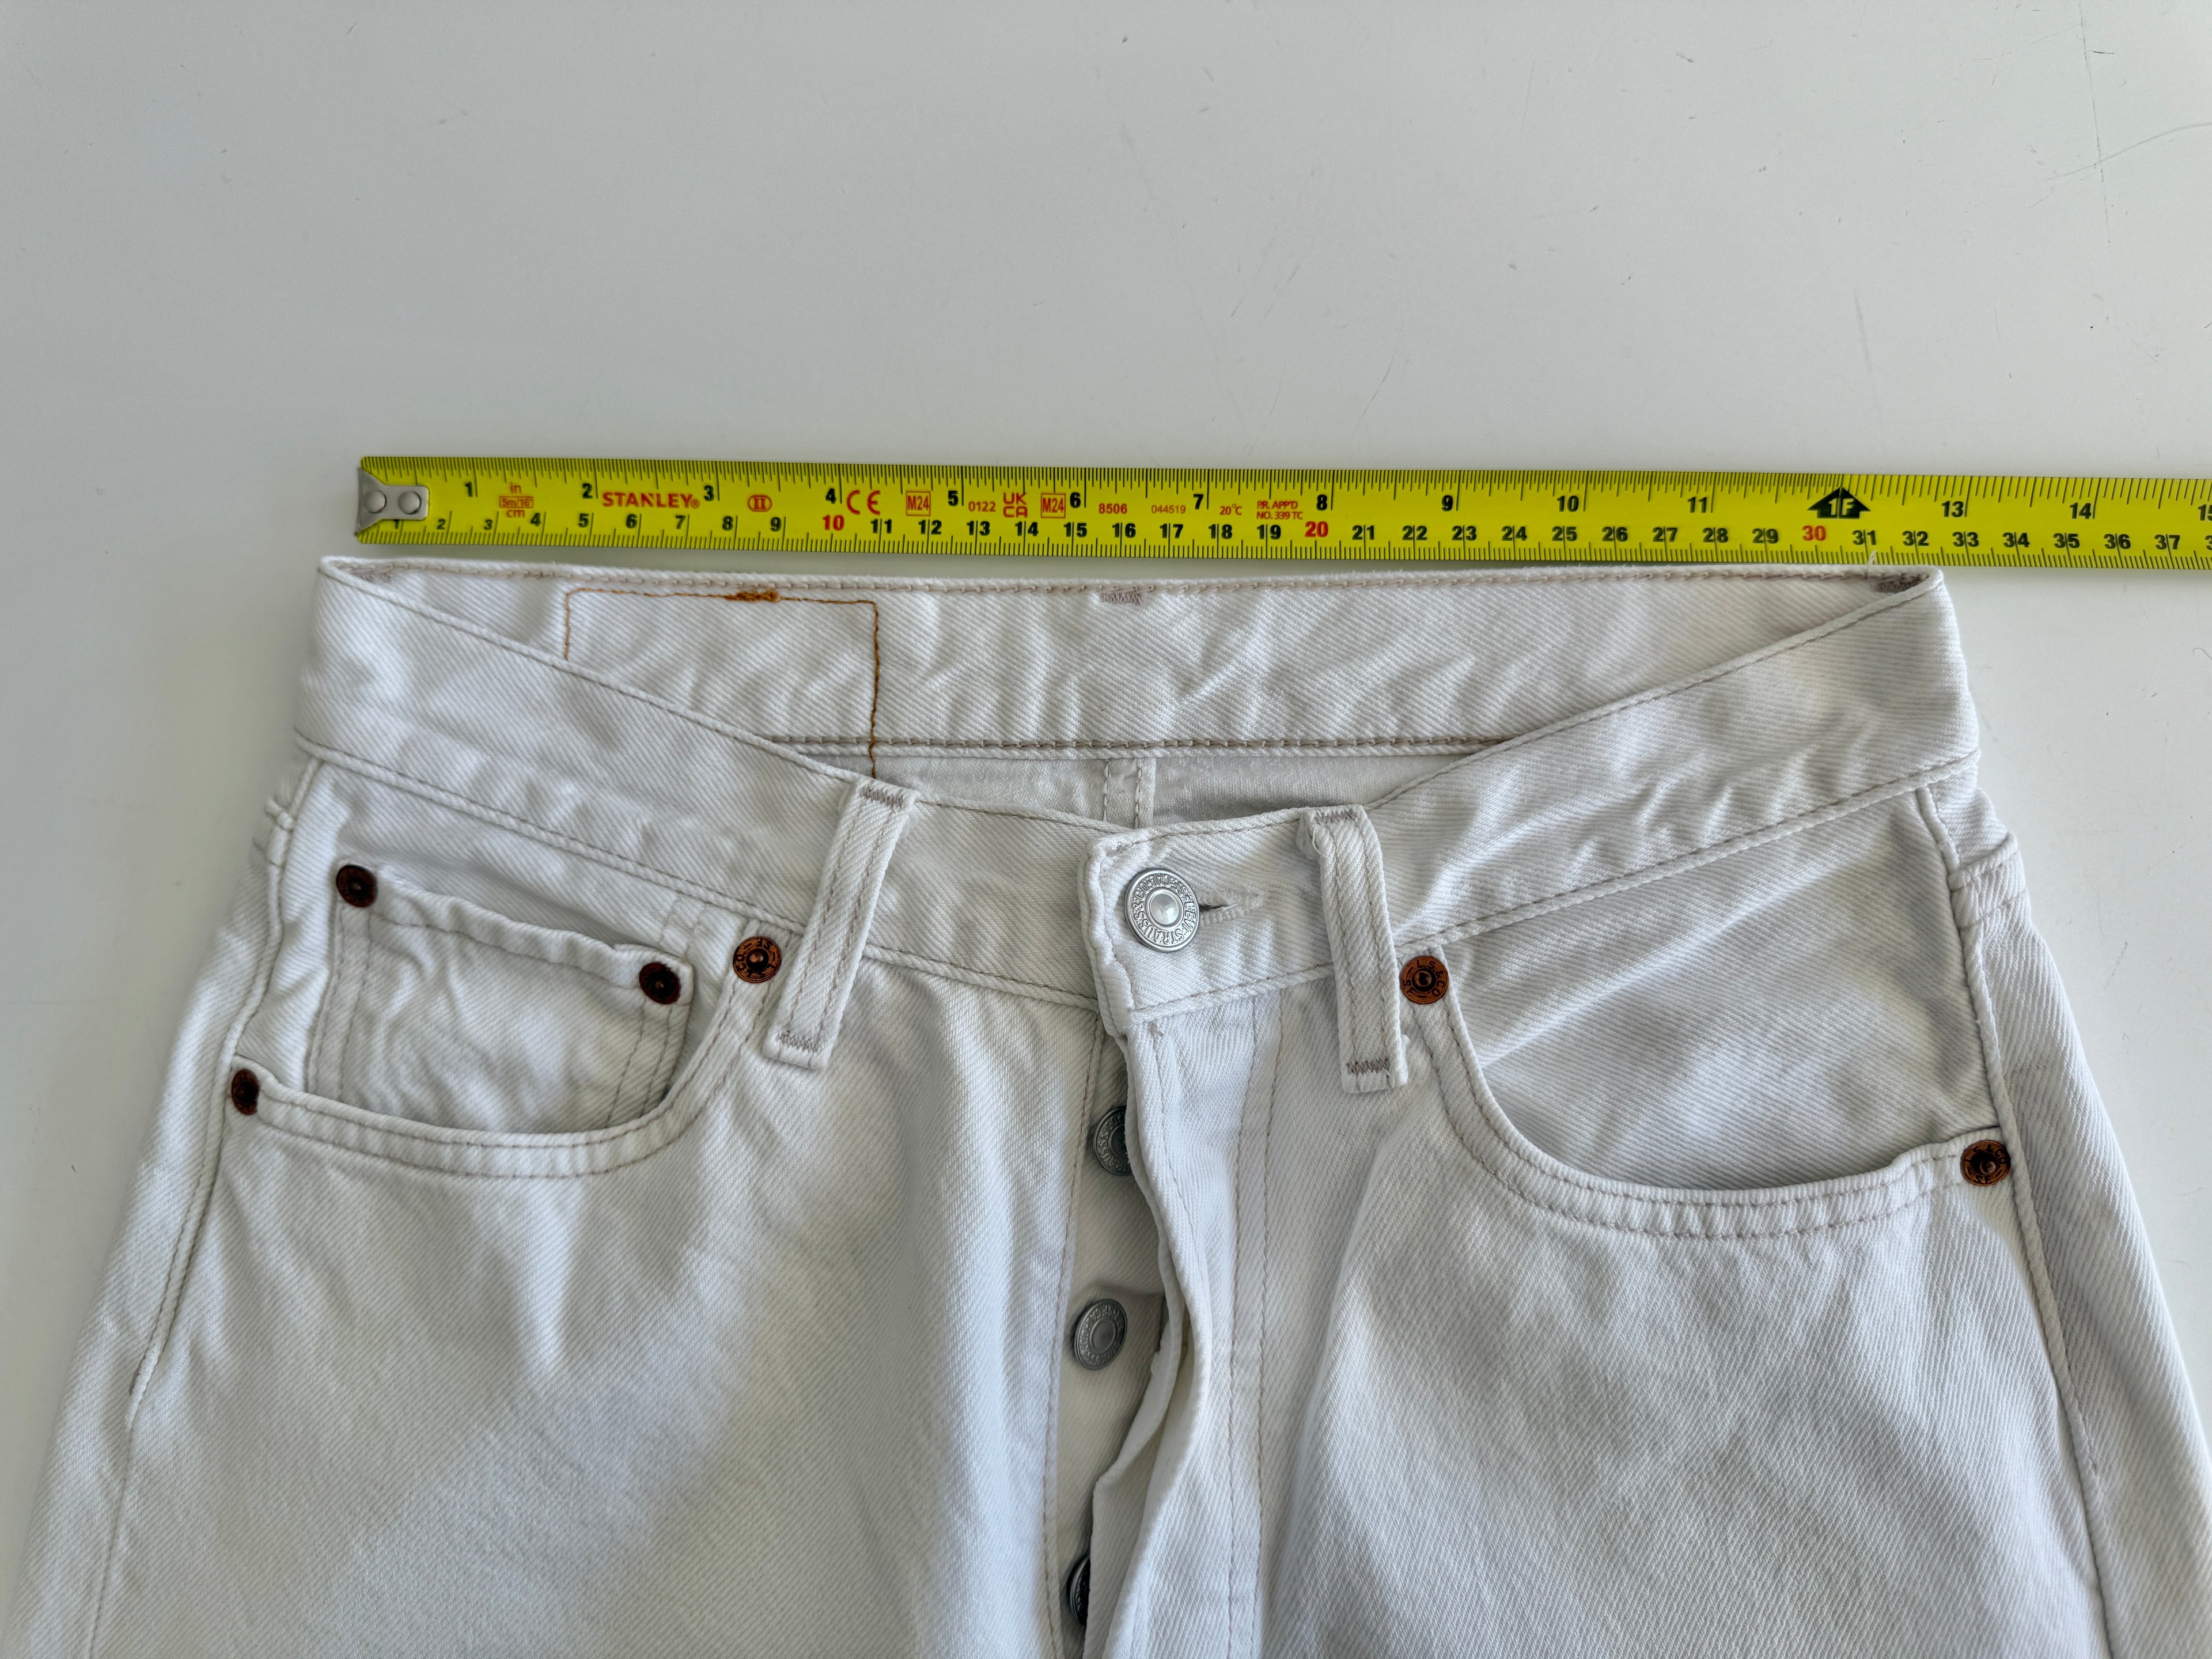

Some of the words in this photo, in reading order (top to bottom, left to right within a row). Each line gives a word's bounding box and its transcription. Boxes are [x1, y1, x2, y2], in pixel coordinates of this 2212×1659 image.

[510, 482, 522, 494] in
[465, 482, 474, 497] 1
[582, 483, 593, 499] 2
[704, 485, 714, 501] 3
[825, 488, 836, 504] 4
[948, 491, 959, 506] 5
[1070, 492, 1081, 508] 6
[1194, 494, 1204, 510] 7
[1316, 494, 1328, 511] 8
[1441, 495, 1453, 512] 9
[1557, 495, 1579, 512] 10
[1688, 497, 1707, 513] 11
[1828, 499, 1855, 516] 1F
[1941, 501, 1963, 517] 13
[2070, 502, 2091, 519] 14
[846, 490, 880, 516] CE
[908, 495, 929, 511] M24
[1003, 493, 1027, 505] UK
[968, 501, 996, 512] 0122
[1042, 498, 1065, 513] M24
[1099, 503, 1127, 514] 8506
[1152, 505, 1185, 514] 044519
[506, 509, 525, 518] cm
[1003, 506, 1028, 518] CA
[1256, 512, 1273, 520] NO.
[1275, 512, 1290, 520] 339
[1292, 512, 1303, 520] TC
[437, 519, 446, 530] 2
[484, 519, 493, 531] 3
[531, 513, 541, 527] 4
[578, 513, 589, 528] 5
[626, 514, 637, 529] 6
[675, 515, 686, 529] 7
[722, 516, 733, 531] 8
[770, 517, 781, 532] 9
[823, 514, 844, 531] 10
[871, 519, 892, 534] 11
[918, 520, 942, 535] 12
[967, 521, 990, 536] 13
[1015, 521, 1039, 536] 14
[1064, 522, 1088, 537] 15
[1112, 523, 1136, 538] 16
[1160, 524, 1184, 539] 17
[1209, 524, 1233, 540] 18
[1257, 524, 1281, 540] 19
[1305, 521, 1328, 537] 20
[1352, 525, 1374, 540] 21
[1402, 525, 1427, 541] 22
[1452, 526, 1477, 541] 23
[1501, 526, 1527, 541] 24
[1551, 527, 1577, 541] 25
[1602, 527, 1628, 542] 26
[1652, 527, 1677, 543] 27
[1702, 527, 1728, 543] 28
[1752, 528, 1778, 544] 29
[1802, 525, 1826, 541] 30
[1852, 530, 1876, 546] 31
[1902, 531, 1929, 547] 32
[1952, 532, 1979, 547] 33
[2002, 532, 2029, 548] 34
[2053, 533, 2080, 548] 35
[2103, 533, 2131, 550] 36
[2154, 534, 2180, 550] 37
[1134, 911, 1185, 945] STRAUSS
